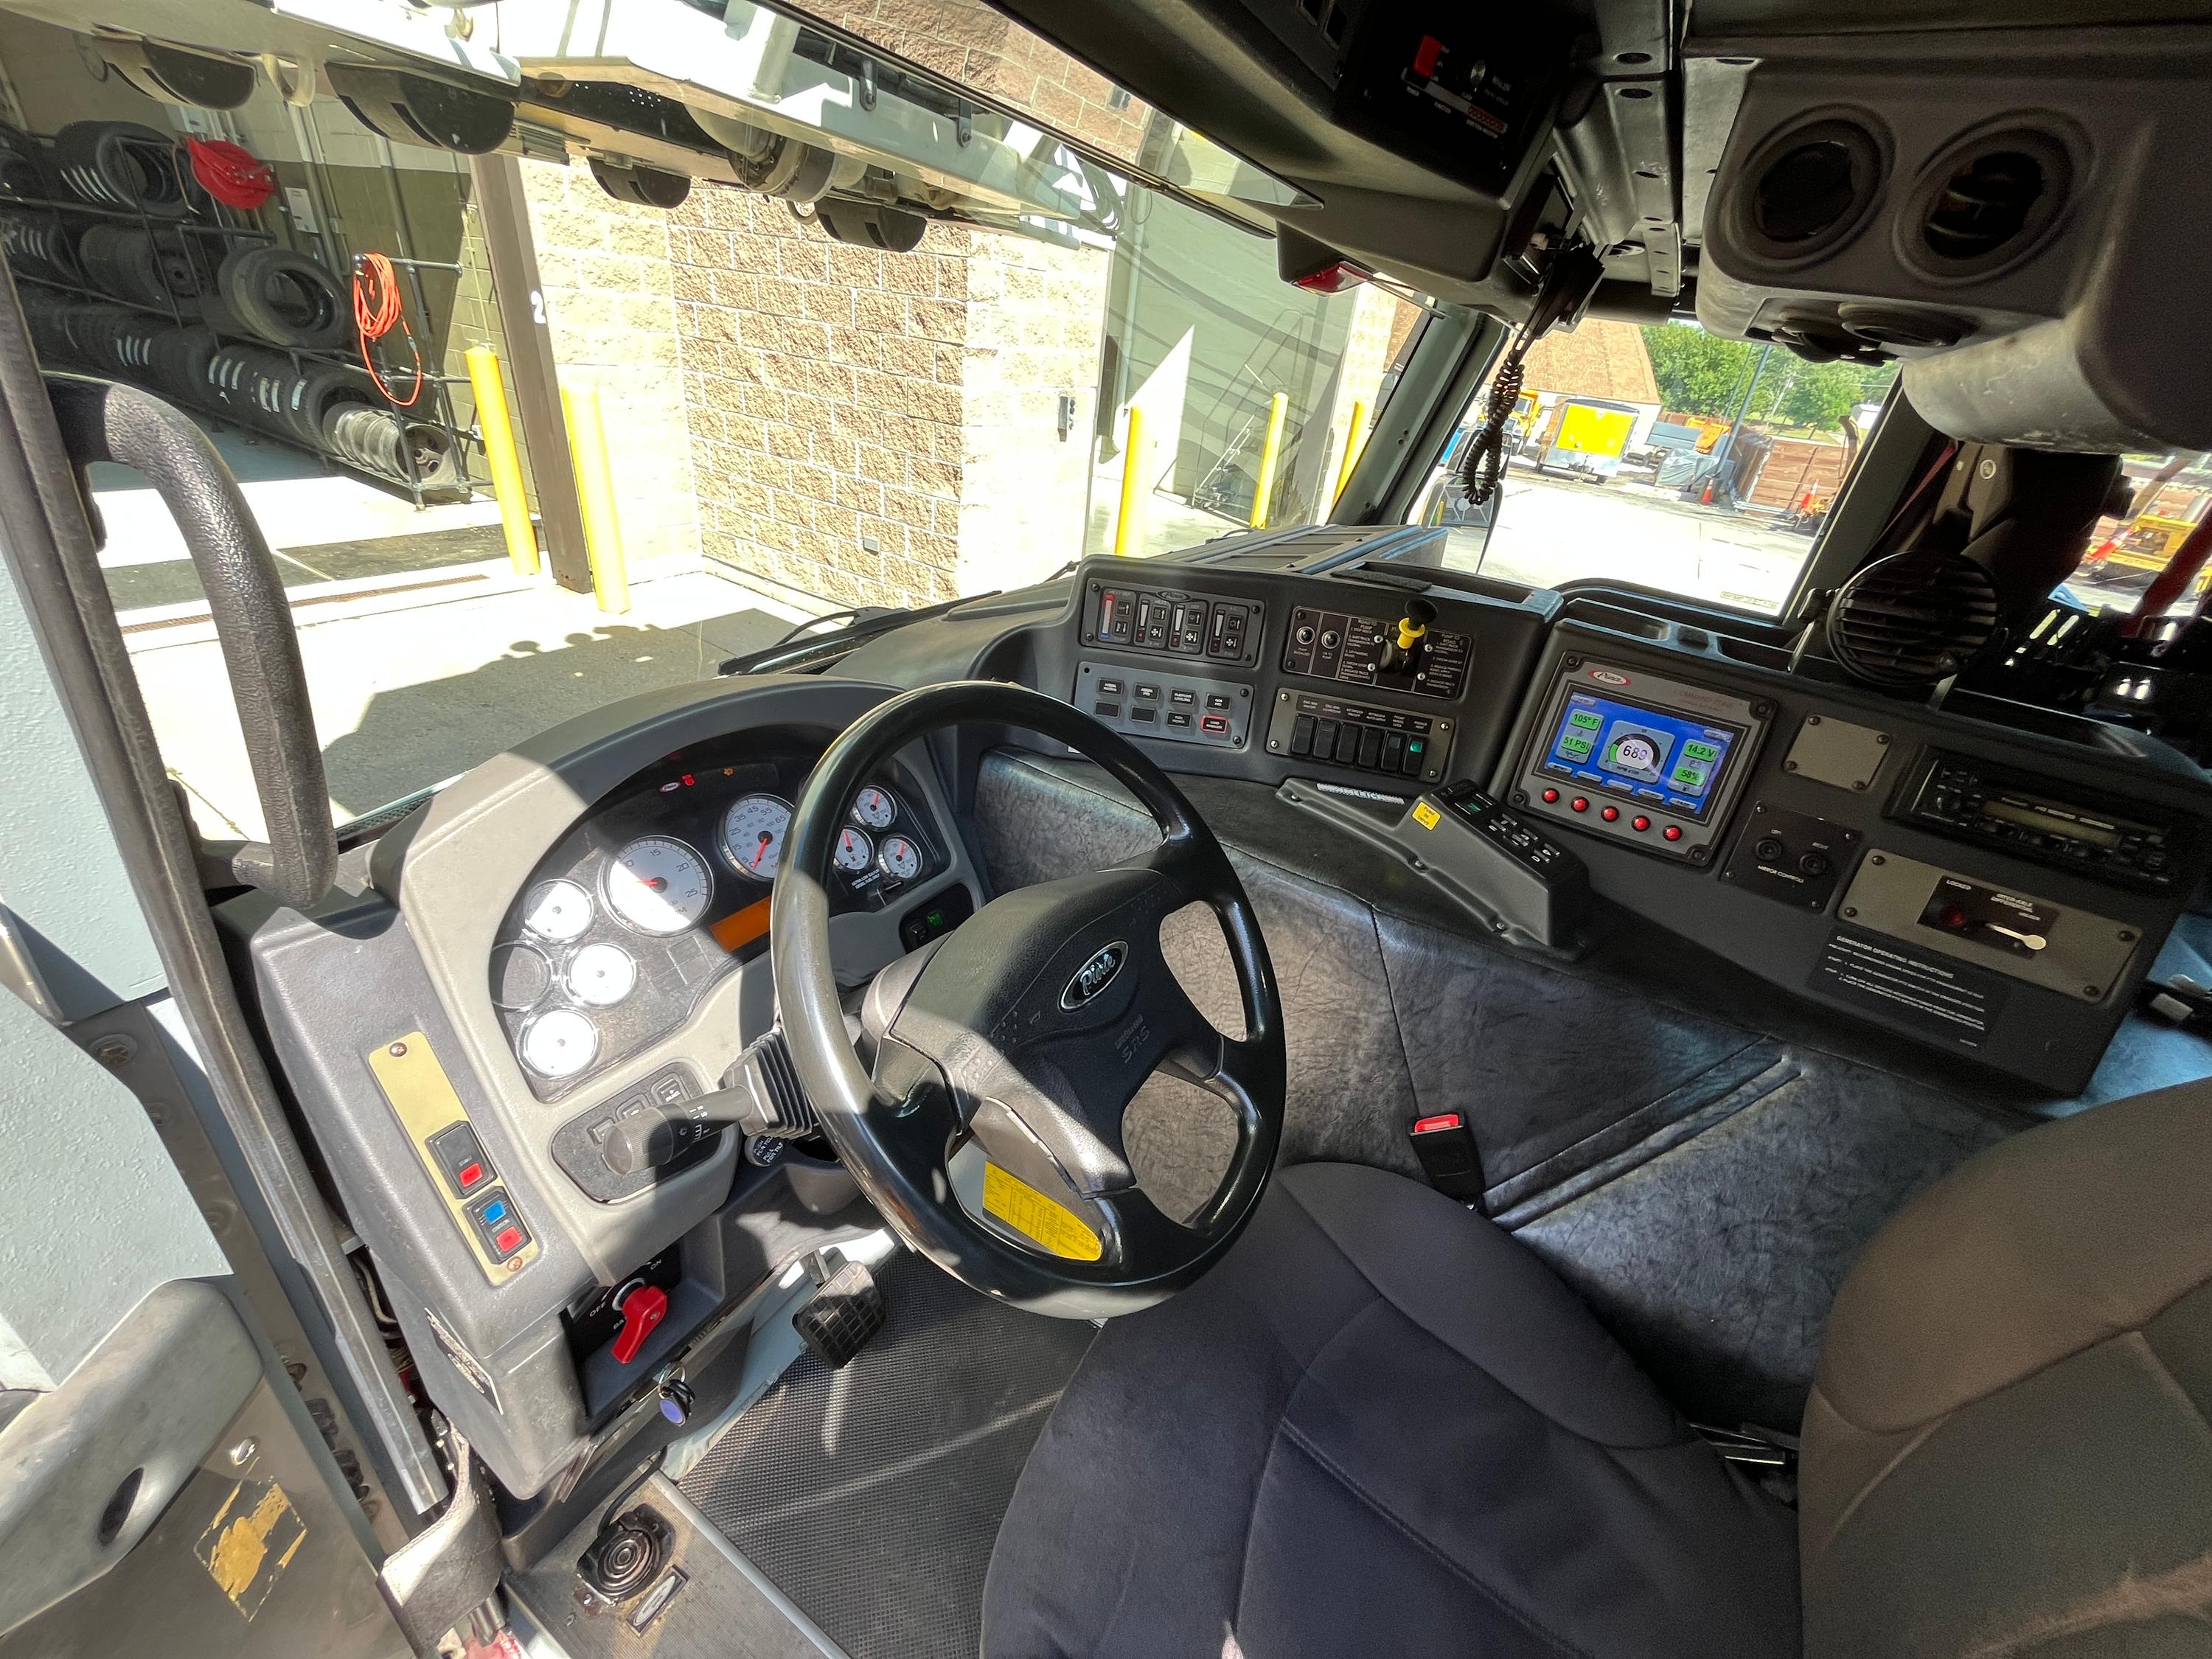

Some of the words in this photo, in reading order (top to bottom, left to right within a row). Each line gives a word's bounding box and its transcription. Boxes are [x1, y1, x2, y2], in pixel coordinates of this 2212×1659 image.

[531, 291, 546, 324] 2
[1562, 737, 1573, 745] 51
[1574, 739, 1590, 750] PSI
[1623, 745, 1648, 761] 689
[1687, 743, 1706, 755] 14.2
[1706, 749, 1714, 757] V
[1681, 769, 1700, 781] 58%
[747, 806, 759, 814] 45
[760, 807, 773, 815] 55
[734, 814, 746, 822] 35
[775, 815, 787, 824] 65
[729, 827, 741, 835] 25
[650, 849, 661, 857] 15
[676, 862, 689, 872] 20
[685, 888, 698, 898] 25
[1837, 936, 1873, 951] GENERATOR
[650, 1259, 662, 1270] ON
[590, 1301, 605, 1317] OFF
